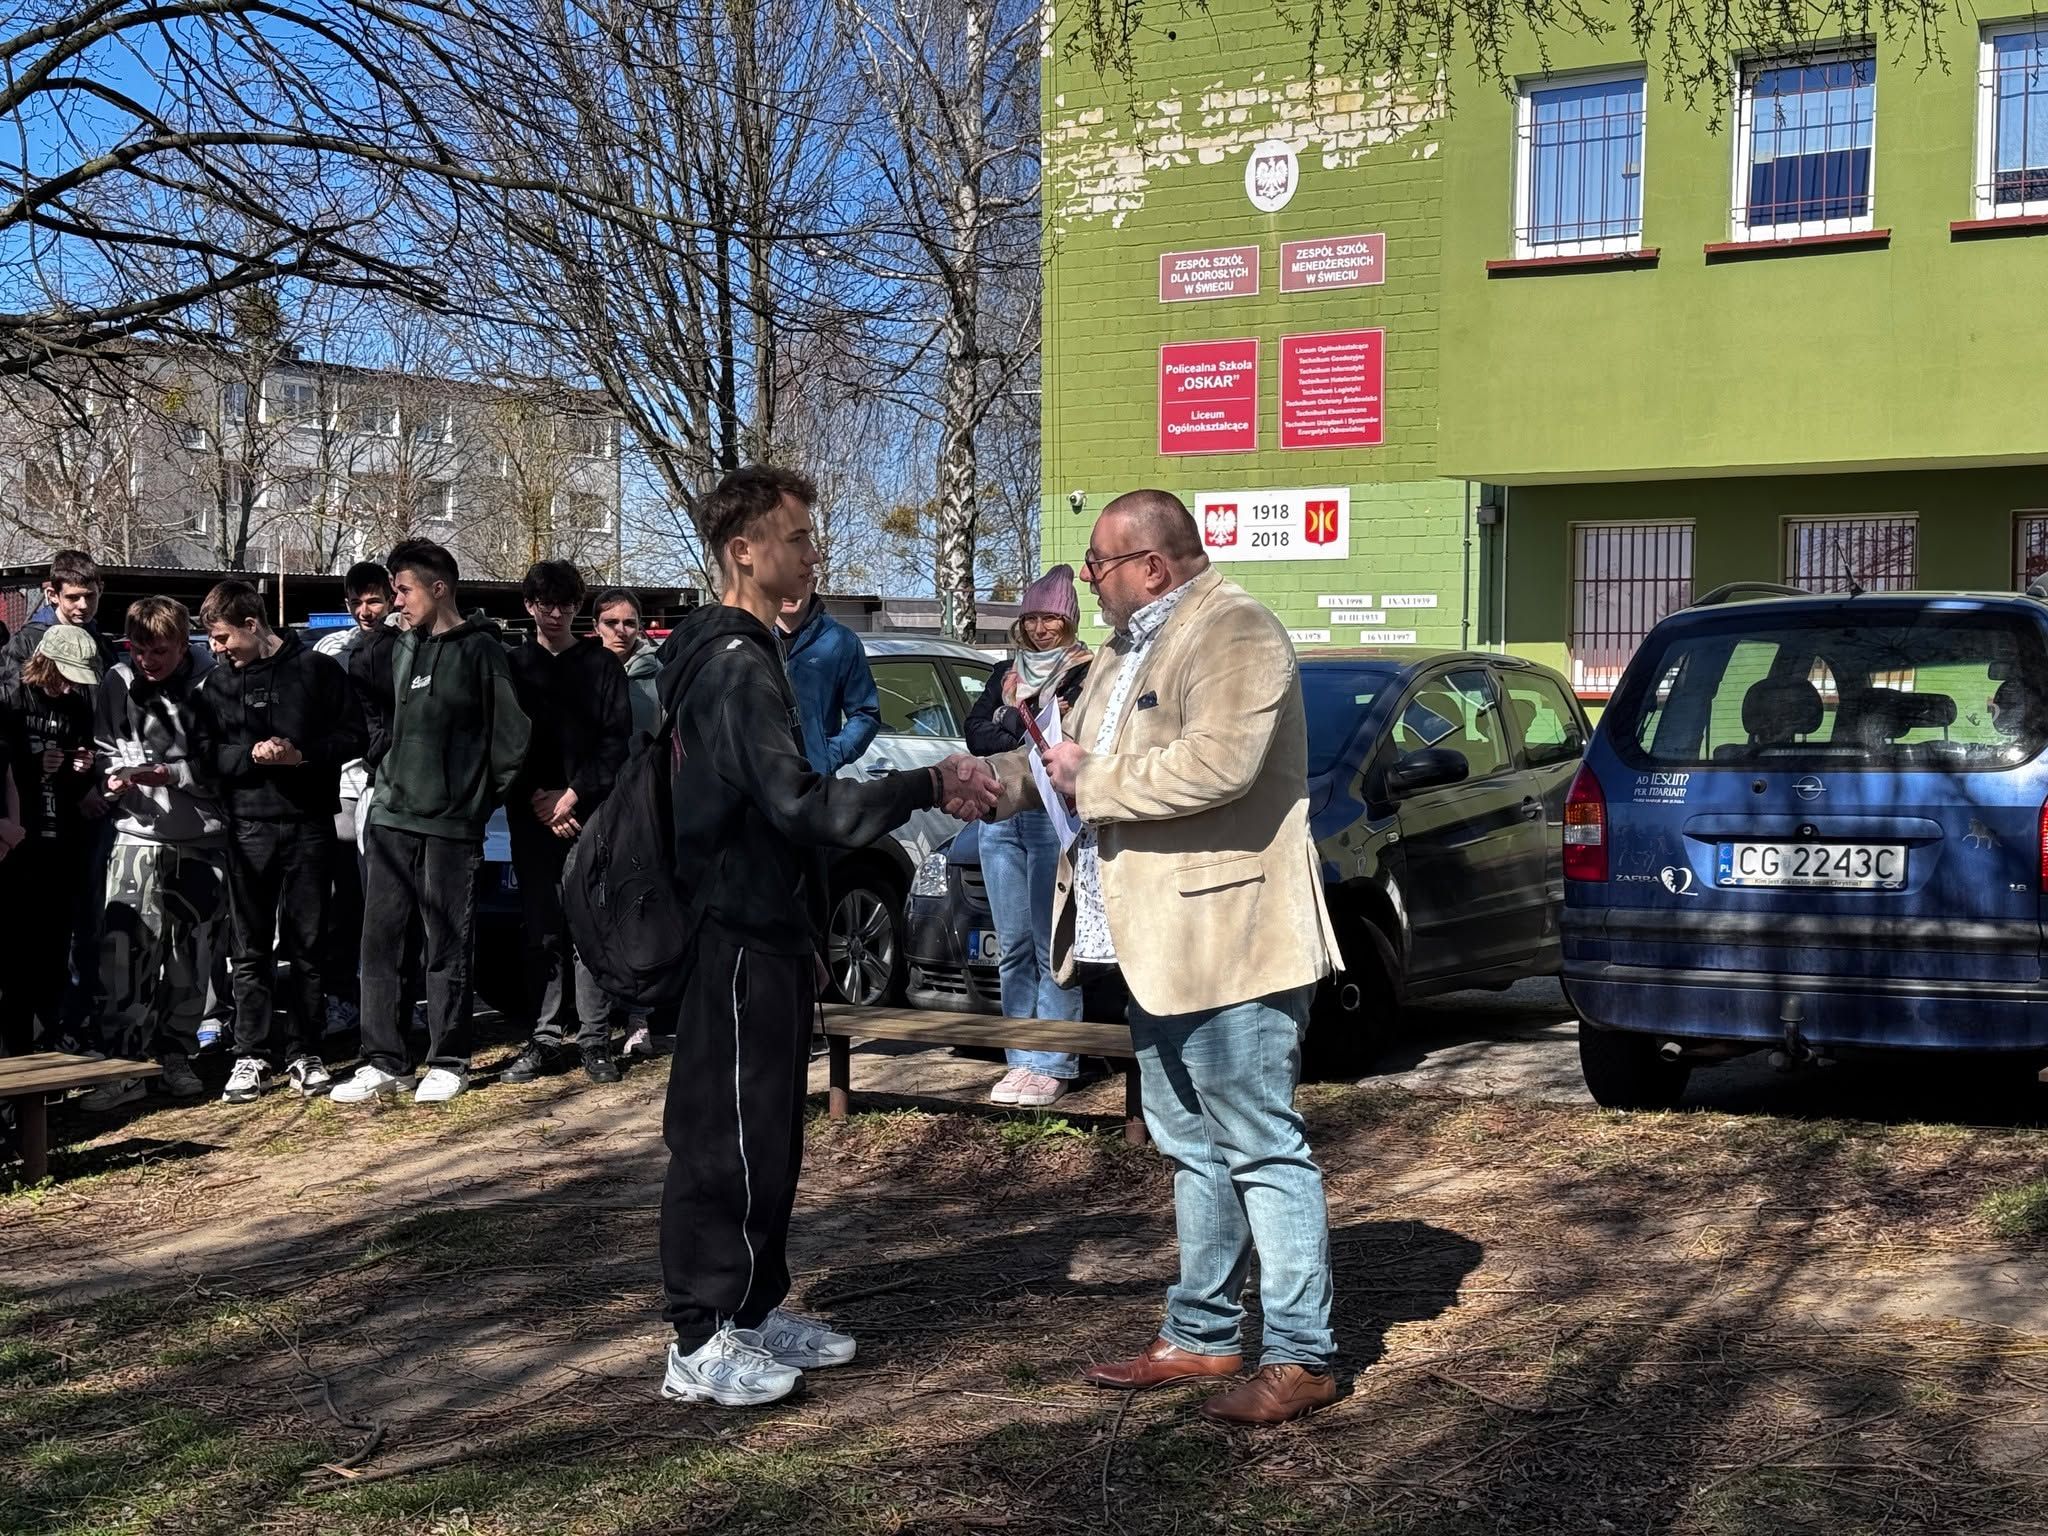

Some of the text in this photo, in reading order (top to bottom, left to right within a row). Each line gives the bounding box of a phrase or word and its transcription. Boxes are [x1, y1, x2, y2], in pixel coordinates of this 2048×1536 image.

[1296, 241, 1369, 260] ZESPÓŁ SZKÓŁ
[1175, 253, 1244, 270] ZESPÓŁ SZKÓŁ
[1292, 255, 1374, 272] MENEDŻERSKICH
[1170, 267, 1249, 283] DLA DOROSŁYCH
[1306, 270, 1358, 284] W ŚWIECIU
[1184, 281, 1234, 294] W ŚWIECIU
[1165, 360, 1253, 375] Policealna Szkoła
[1191, 410, 1225, 420] Liceum
[1167, 422, 1249, 435] Ogólnokształcące
[1252, 504, 1289, 520] 1918
[1251, 531, 1290, 547] 2018
[1635, 776, 1649, 785] AD
[1633, 787, 1648, 796] PER
[1719, 864, 1731, 873] PL
[1739, 846, 1895, 879] CG 2243C
[1616, 874, 1660, 882] ZAFIRA
[772, 1330, 797, 1350] N
[709, 1362, 734, 1381] N
